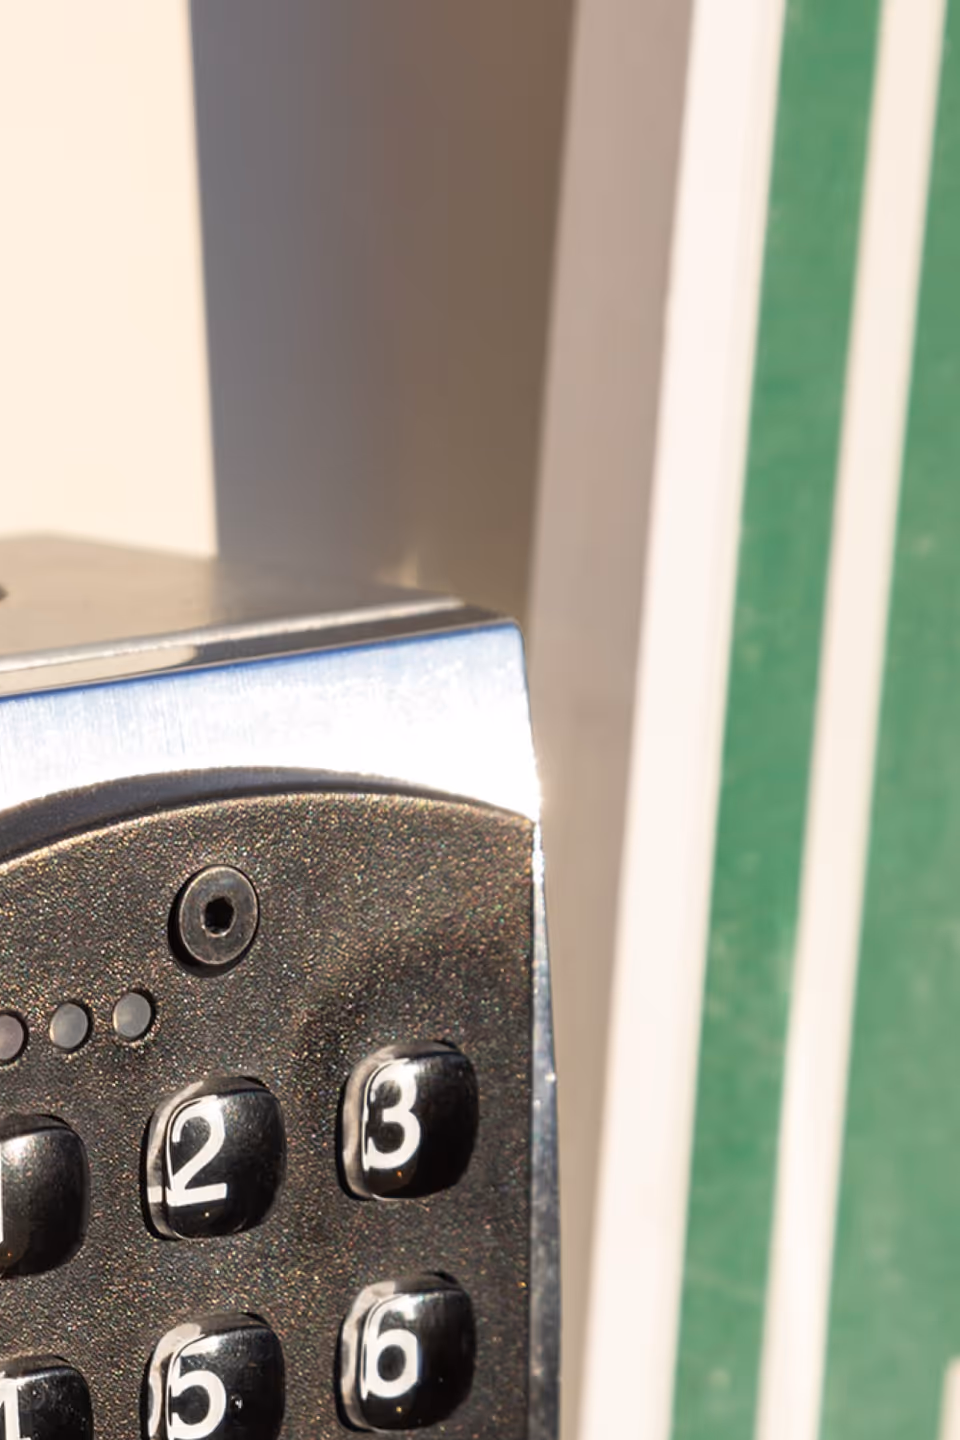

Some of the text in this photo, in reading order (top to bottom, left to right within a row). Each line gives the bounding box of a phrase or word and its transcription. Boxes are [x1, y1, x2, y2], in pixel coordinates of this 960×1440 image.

[165, 1095, 228, 1207] 2
[361, 1058, 422, 1172] 3
[361, 1293, 419, 1401] 6
